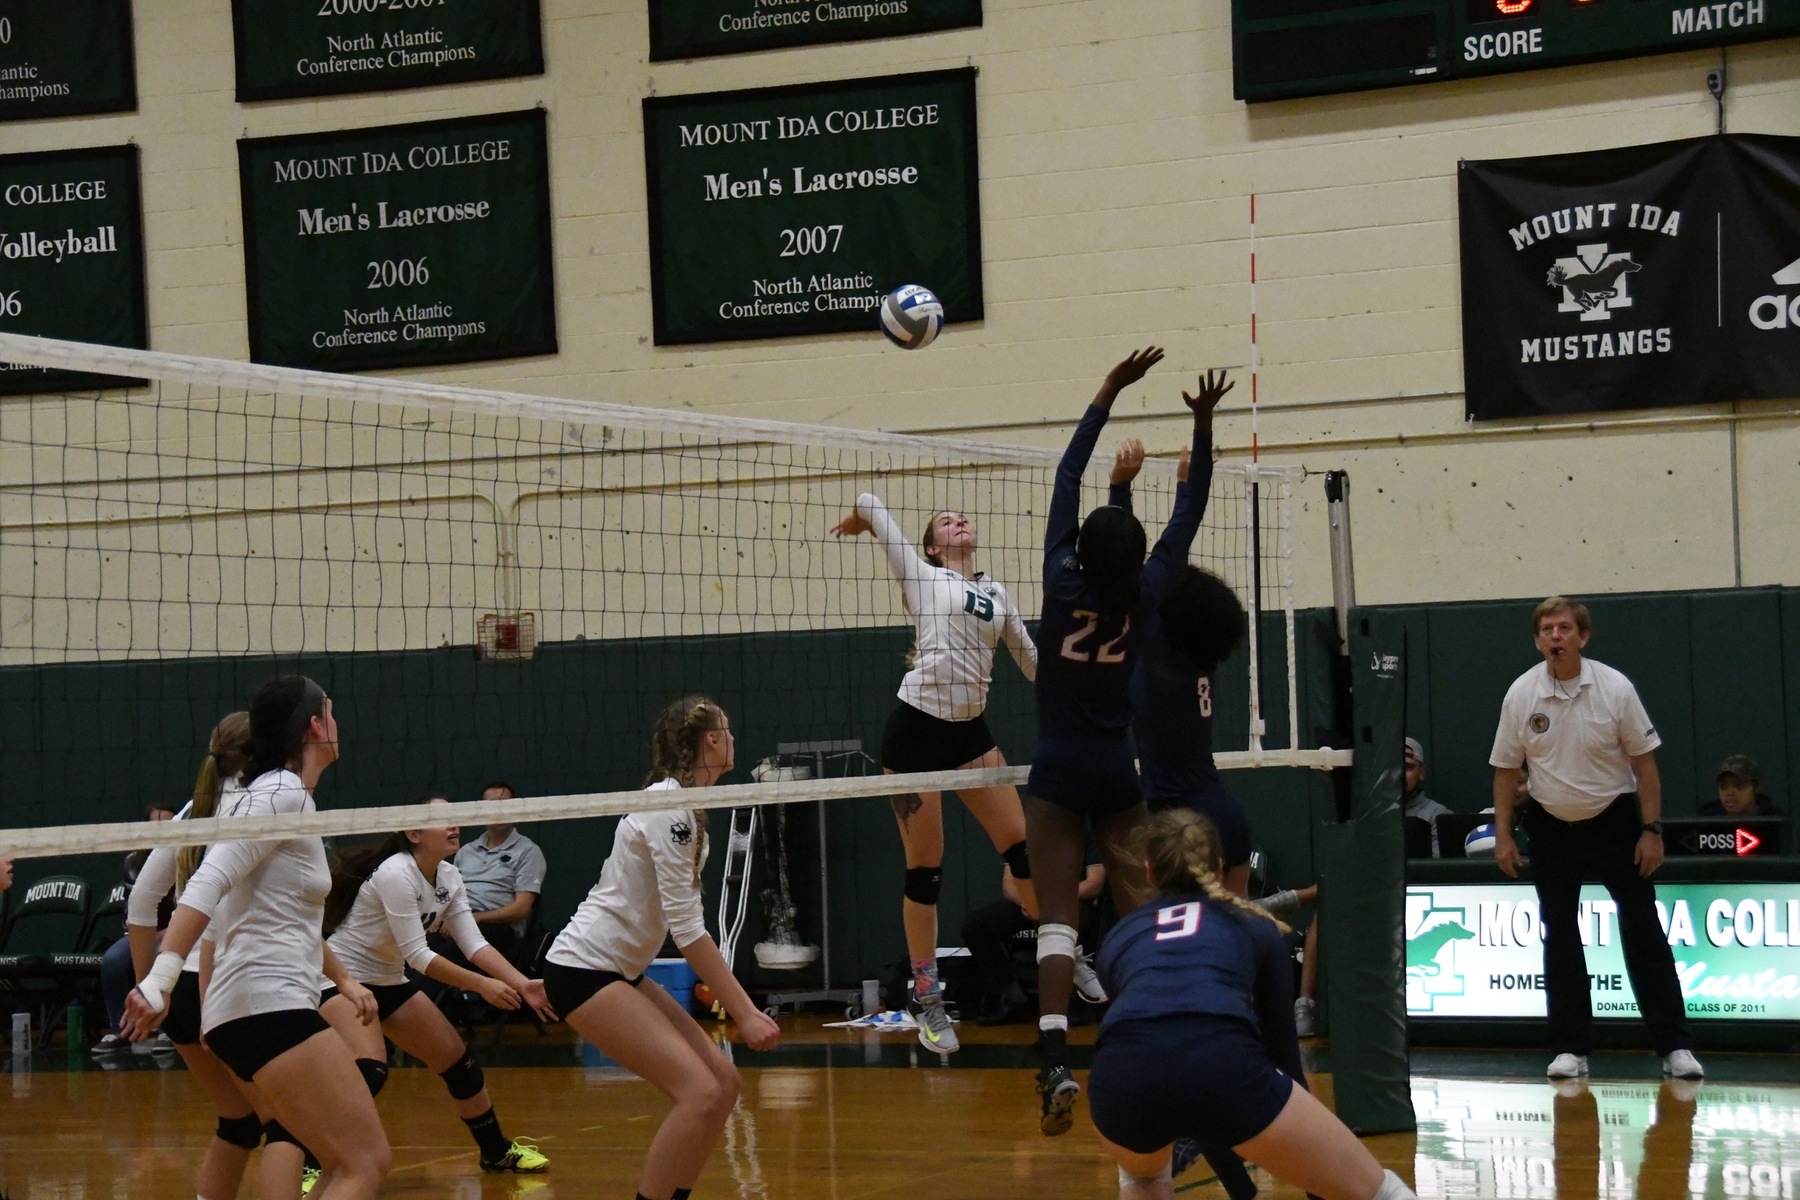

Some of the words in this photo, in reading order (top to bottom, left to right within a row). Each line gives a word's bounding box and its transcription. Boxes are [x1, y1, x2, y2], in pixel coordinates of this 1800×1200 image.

[718, 10, 811, 32] Conference
[815, 0, 909, 22] Champions
[1671, 0, 1766, 35] MATCH
[326, 33, 374, 53] North
[381, 27, 443, 49] Atlantic
[1463, 28, 1543, 61] SCORE
[0, 62, 38, 81] antic
[297, 55, 384, 76] Conference
[388, 45, 476, 68] Champions
[0, 80, 70, 102] hampions
[703, 168, 783, 201] Men's
[792, 165, 919, 194] Lacrosse
[297, 202, 370, 236] Men's
[377, 200, 491, 229] Lacrosse
[1508, 203, 1617, 251] MOUNT
[1628, 203, 1682, 237] IDA
[779, 224, 844, 257] 2007
[367, 256, 430, 289] 2006
[753, 276, 802, 297] North
[807, 270, 873, 292] Atlantic
[344, 307, 389, 326] North
[393, 301, 453, 323] Atlantic
[719, 299, 810, 319] Conference
[814, 290, 888, 312] Champi
[312, 329, 398, 349] Conference
[402, 320, 486, 342] Champions
[1521, 327, 1671, 363] MUSTANGS
[964, 590, 994, 622] 13
[1059, 609, 1131, 663] 22
[1699, 834, 1735, 849] POSS
[25, 881, 65, 904] MOUNT
[64, 882, 82, 901] IDA
[1154, 900, 1204, 942] 9
[1479, 900, 1617, 947] MONT
[54, 956, 103, 965] MUSTANGS
[1489, 974, 1546, 990] HOME
[1588, 974, 1622, 990] THE
[1597, 1002, 1640, 1012] DONATE
[1687, 1003, 1720, 1013] CLASS
[1723, 1003, 1737, 1013] OF
[1741, 1004, 1766, 1013] 2011
